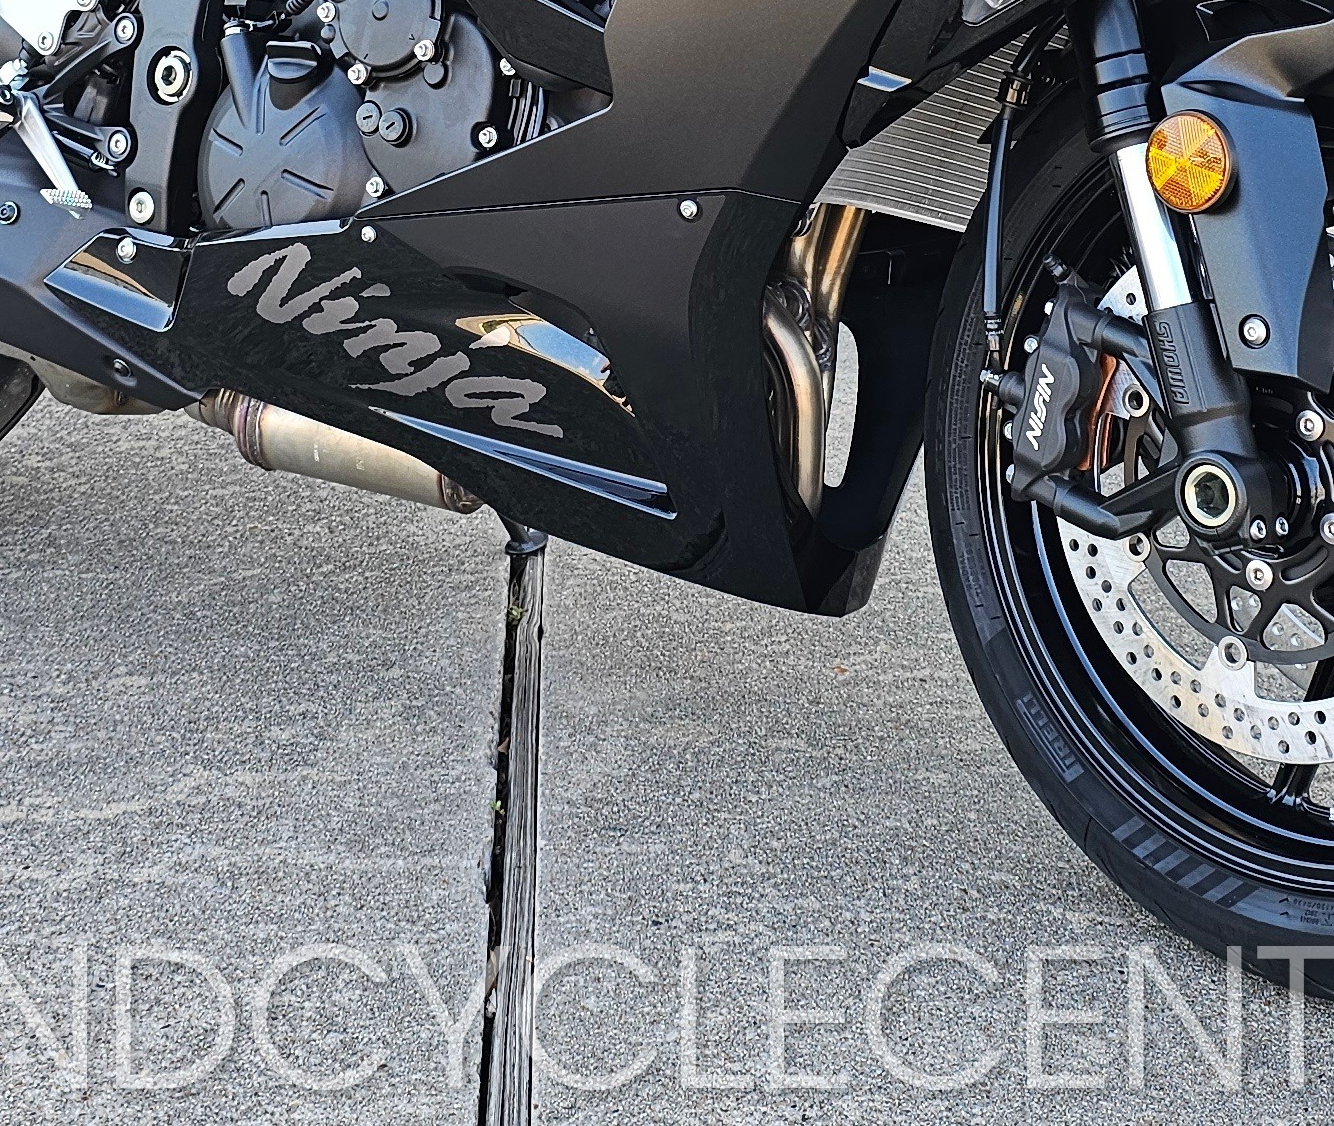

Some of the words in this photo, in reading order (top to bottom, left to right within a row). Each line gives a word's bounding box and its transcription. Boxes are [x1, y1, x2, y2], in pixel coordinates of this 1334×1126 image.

[227, 241, 564, 438] Ninja
[1154, 320, 1190, 406] SHOWA
[1015, 691, 1085, 783] PIRELLI
